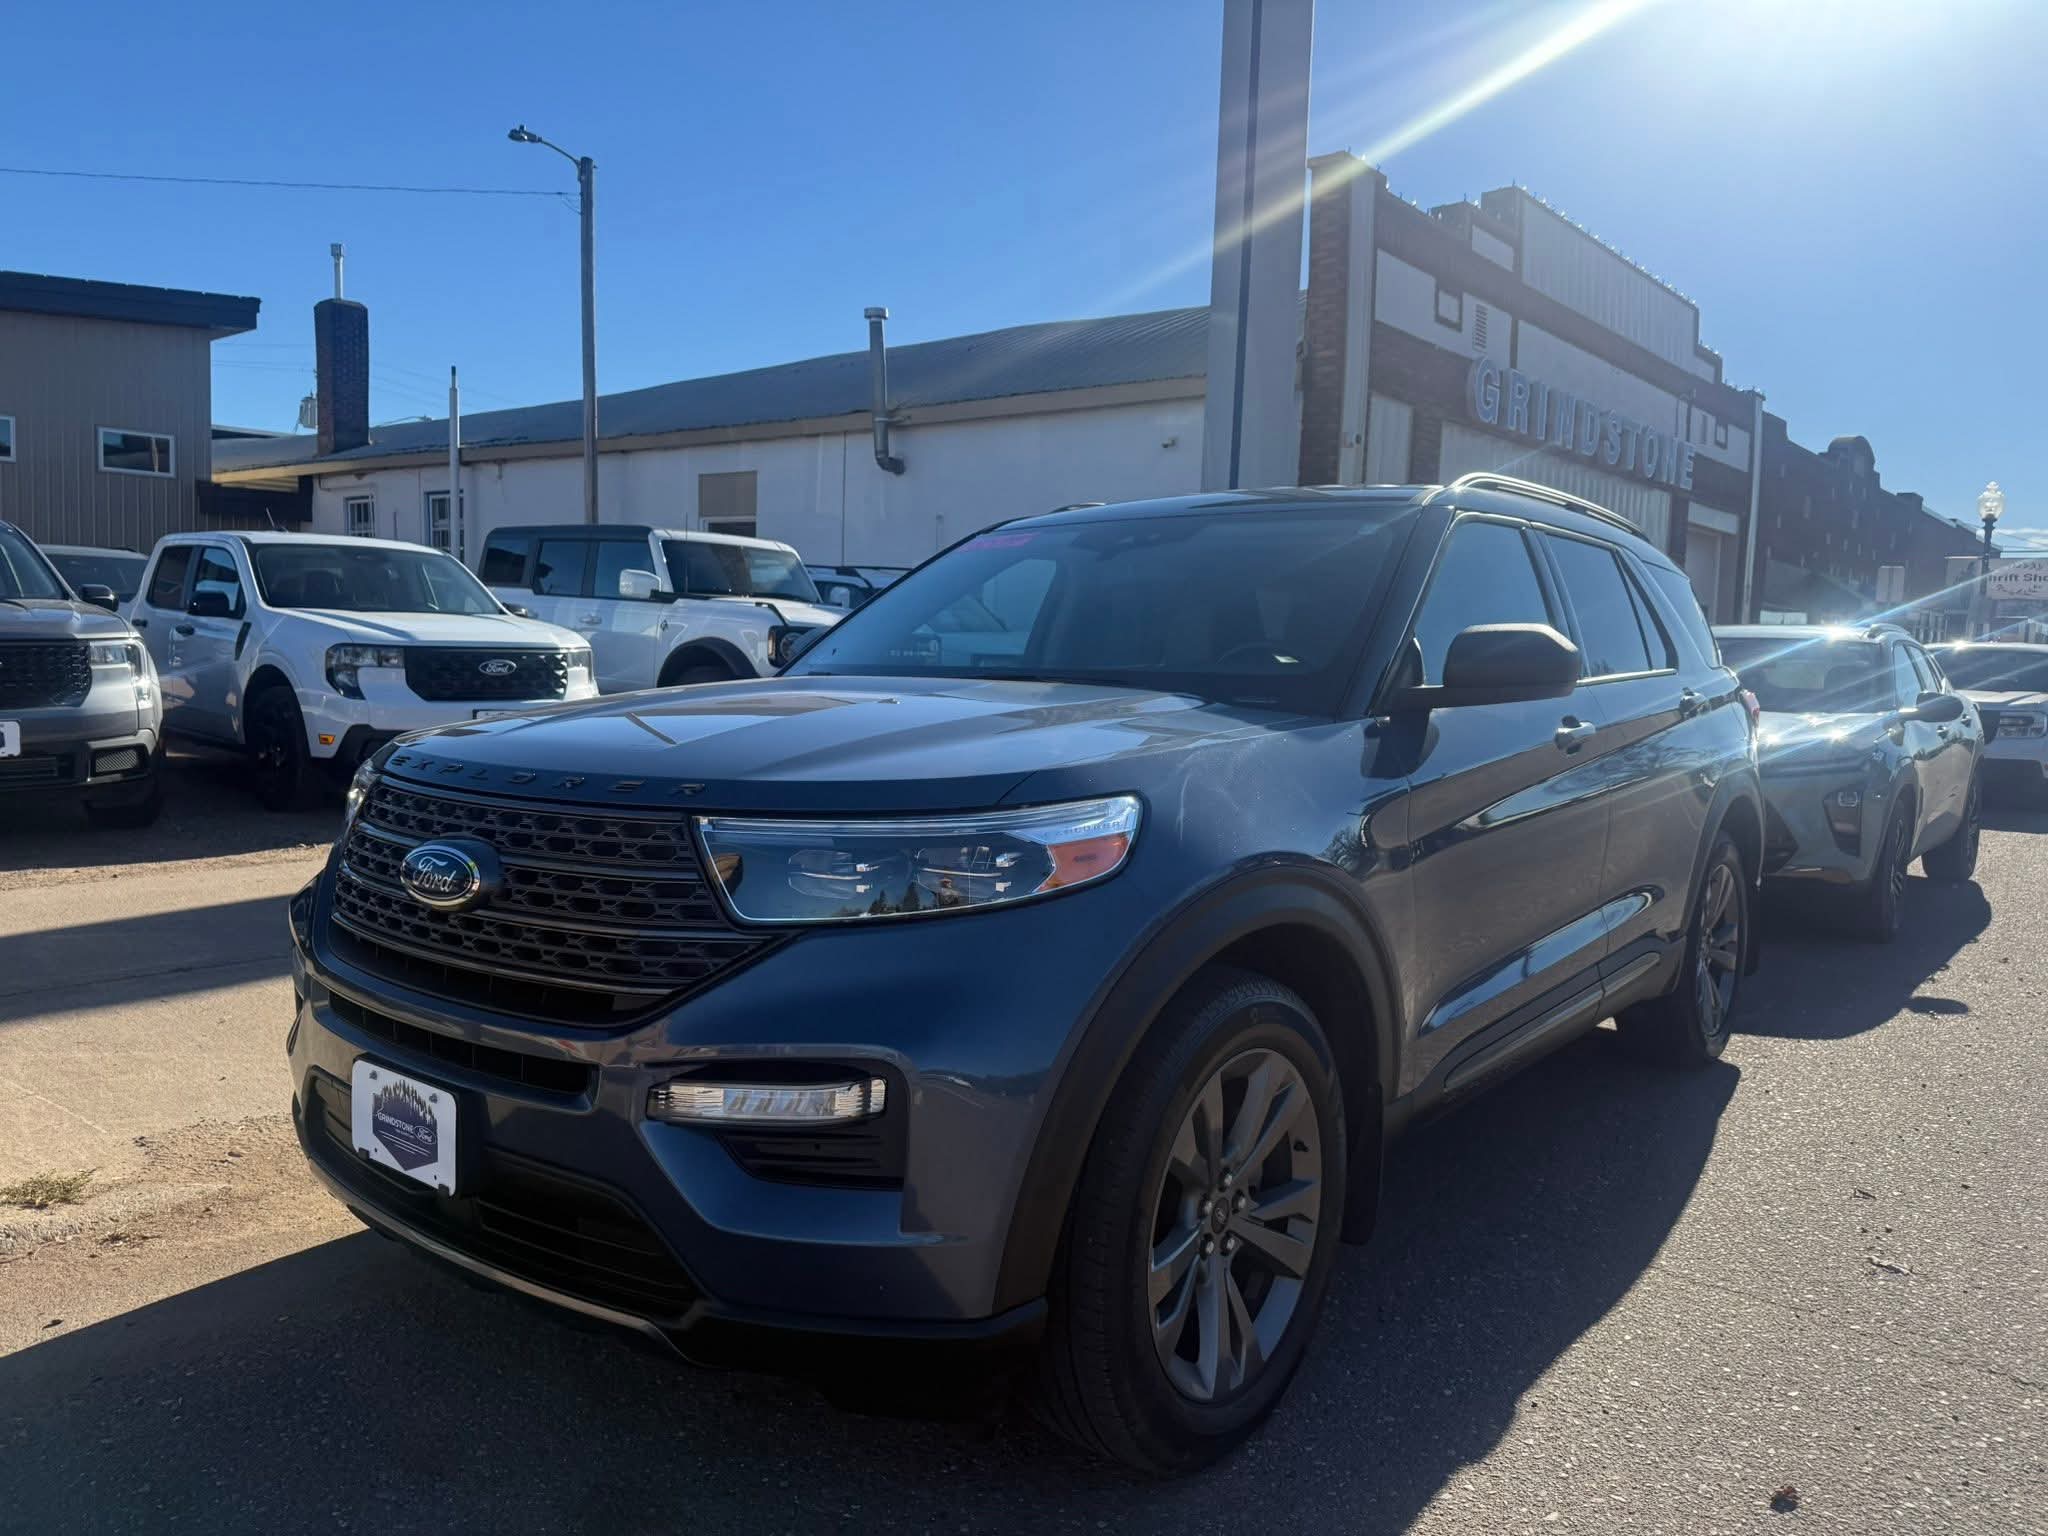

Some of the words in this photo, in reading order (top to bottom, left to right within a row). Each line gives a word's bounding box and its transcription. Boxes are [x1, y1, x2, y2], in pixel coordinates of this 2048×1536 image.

[1470, 356, 1696, 490] GRINDSTONE
[1987, 573, 2019, 582] hrift
[486, 664, 508, 673] Ford
[391, 756, 706, 797] EXPLORER
[413, 856, 457, 893] Ford
[378, 1112, 414, 1134] GRINDSTONE
[417, 1127, 433, 1142] Ford
